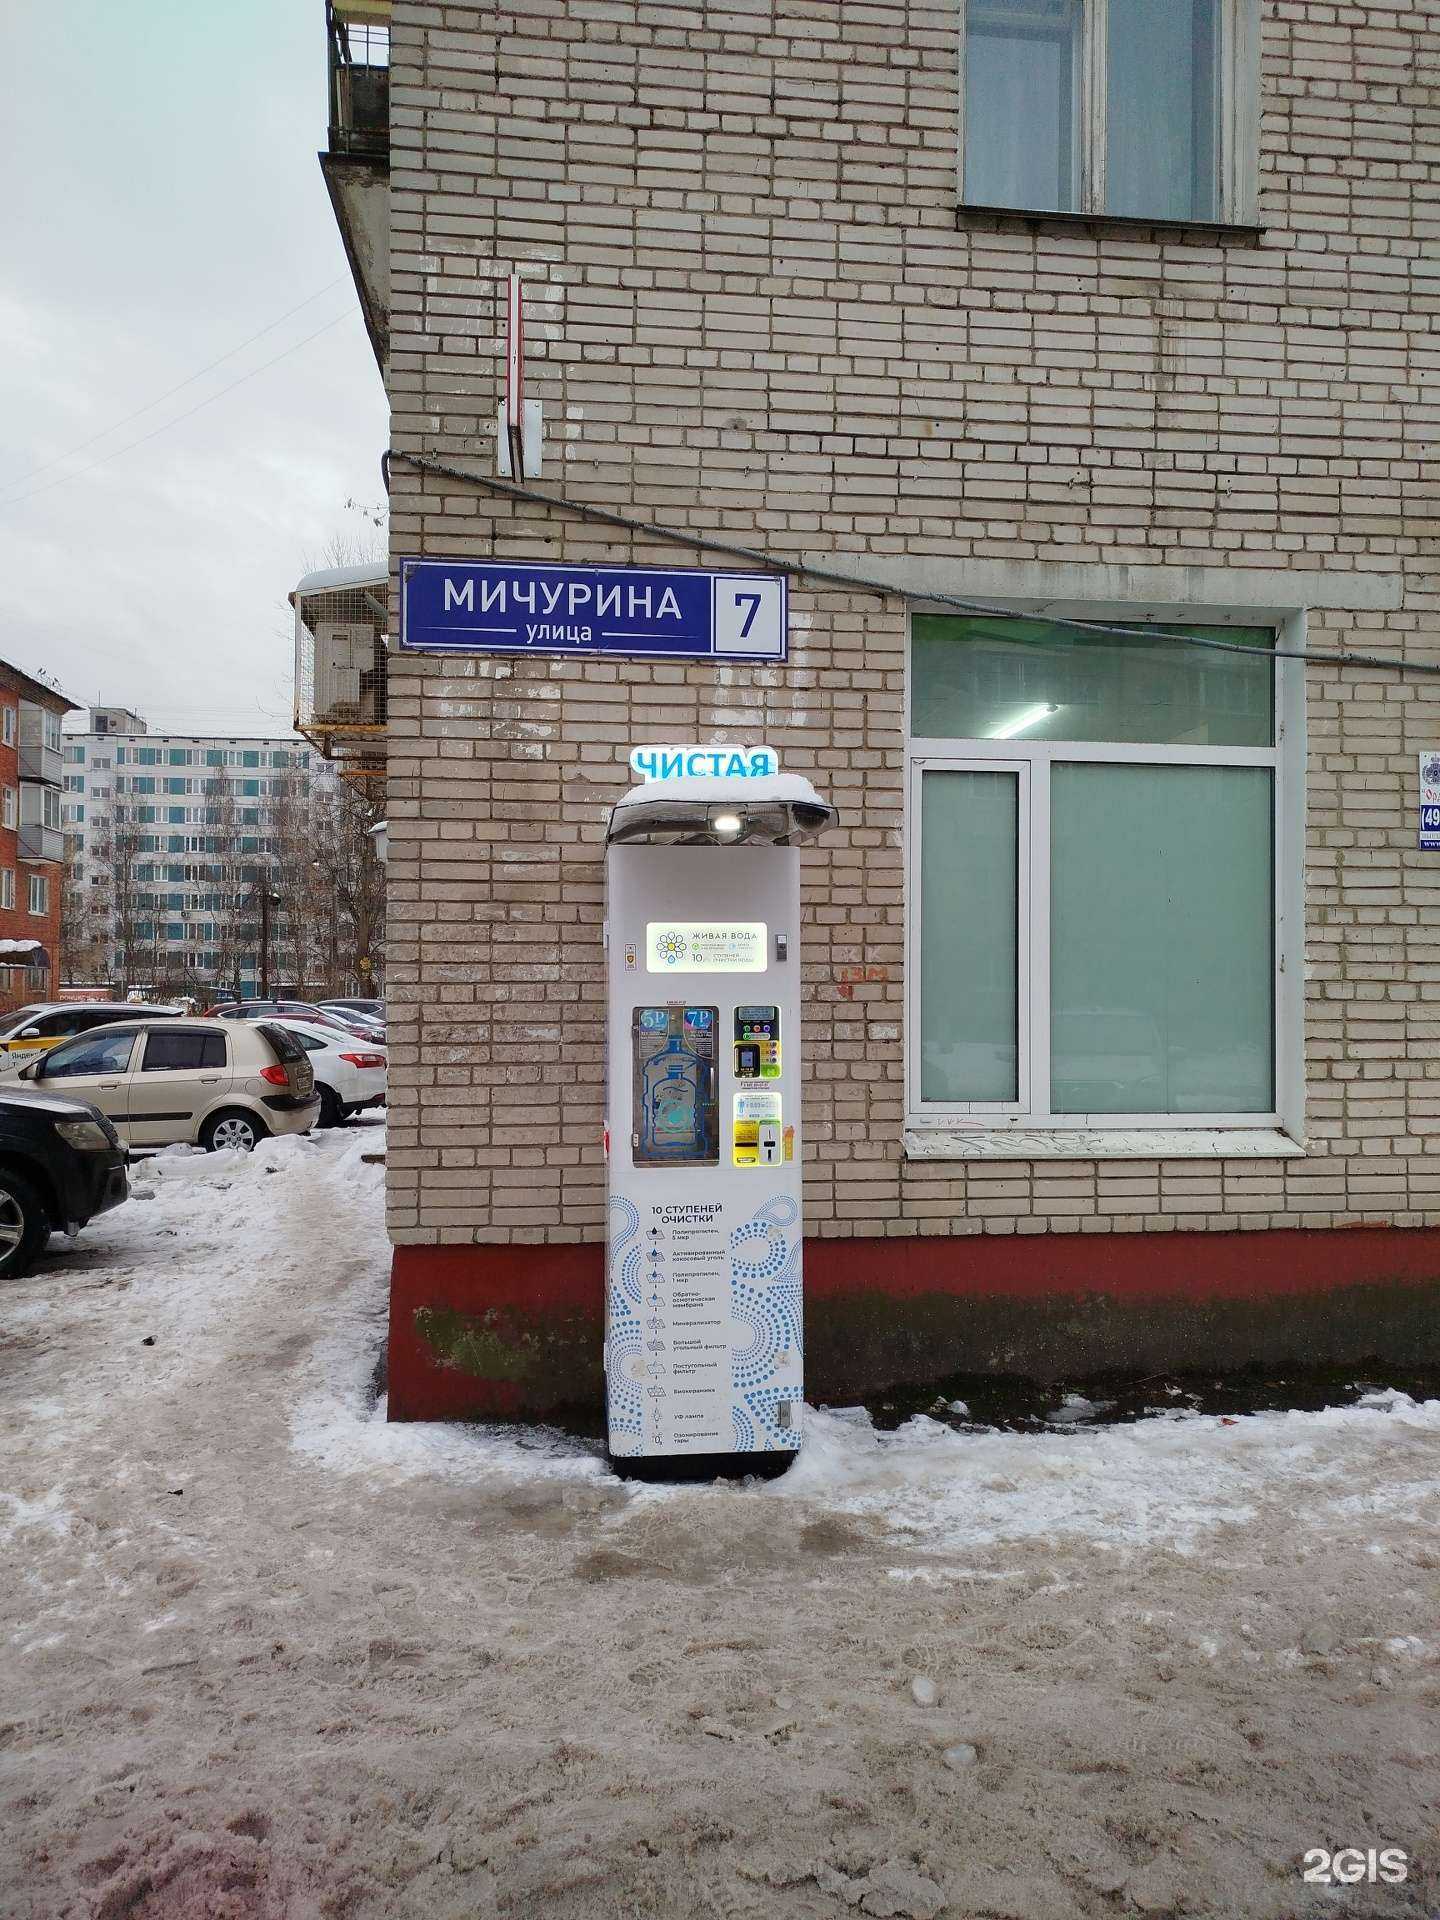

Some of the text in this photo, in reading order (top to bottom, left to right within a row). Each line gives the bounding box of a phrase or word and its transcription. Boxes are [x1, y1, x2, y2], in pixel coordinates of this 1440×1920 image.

[443, 577, 683, 619] МИЧУРИНА
[734, 592, 762, 639] 7
[525, 622, 593, 643] улица
[637, 752, 769, 778] ЧИСТАЯ
[692, 932, 757, 940] ЖИВАЯ ВОДА
[652, 1202, 722, 1214] 10 СТУПЕНЕЙ
[661, 1214, 713, 1223] ОЧИСТКИ
